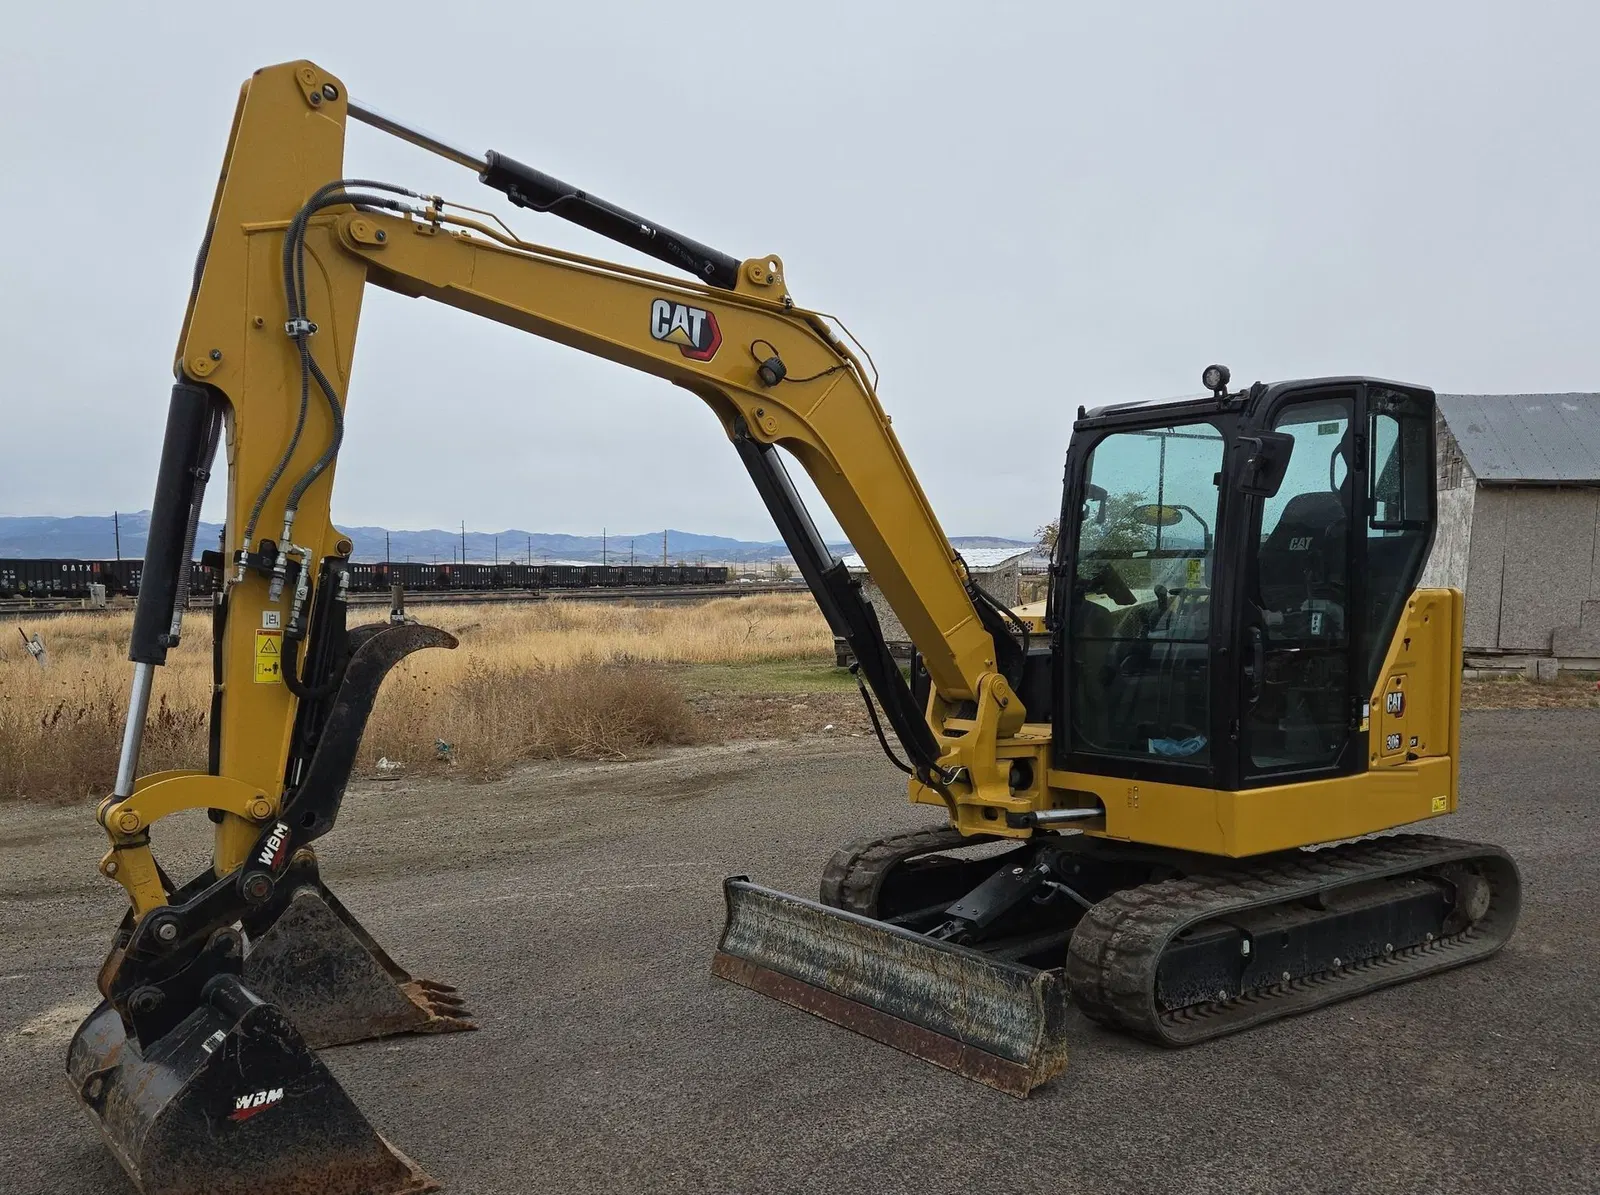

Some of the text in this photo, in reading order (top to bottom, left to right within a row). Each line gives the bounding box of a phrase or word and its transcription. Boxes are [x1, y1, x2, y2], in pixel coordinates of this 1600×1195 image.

[652, 299, 707, 348] CAT
[1289, 536, 1313, 551] CAT
[1387, 692, 1403, 713] CAT
[1386, 734, 1400, 750] 306
[258, 822, 288, 866] WBM
[236, 1088, 283, 1109] WBM
